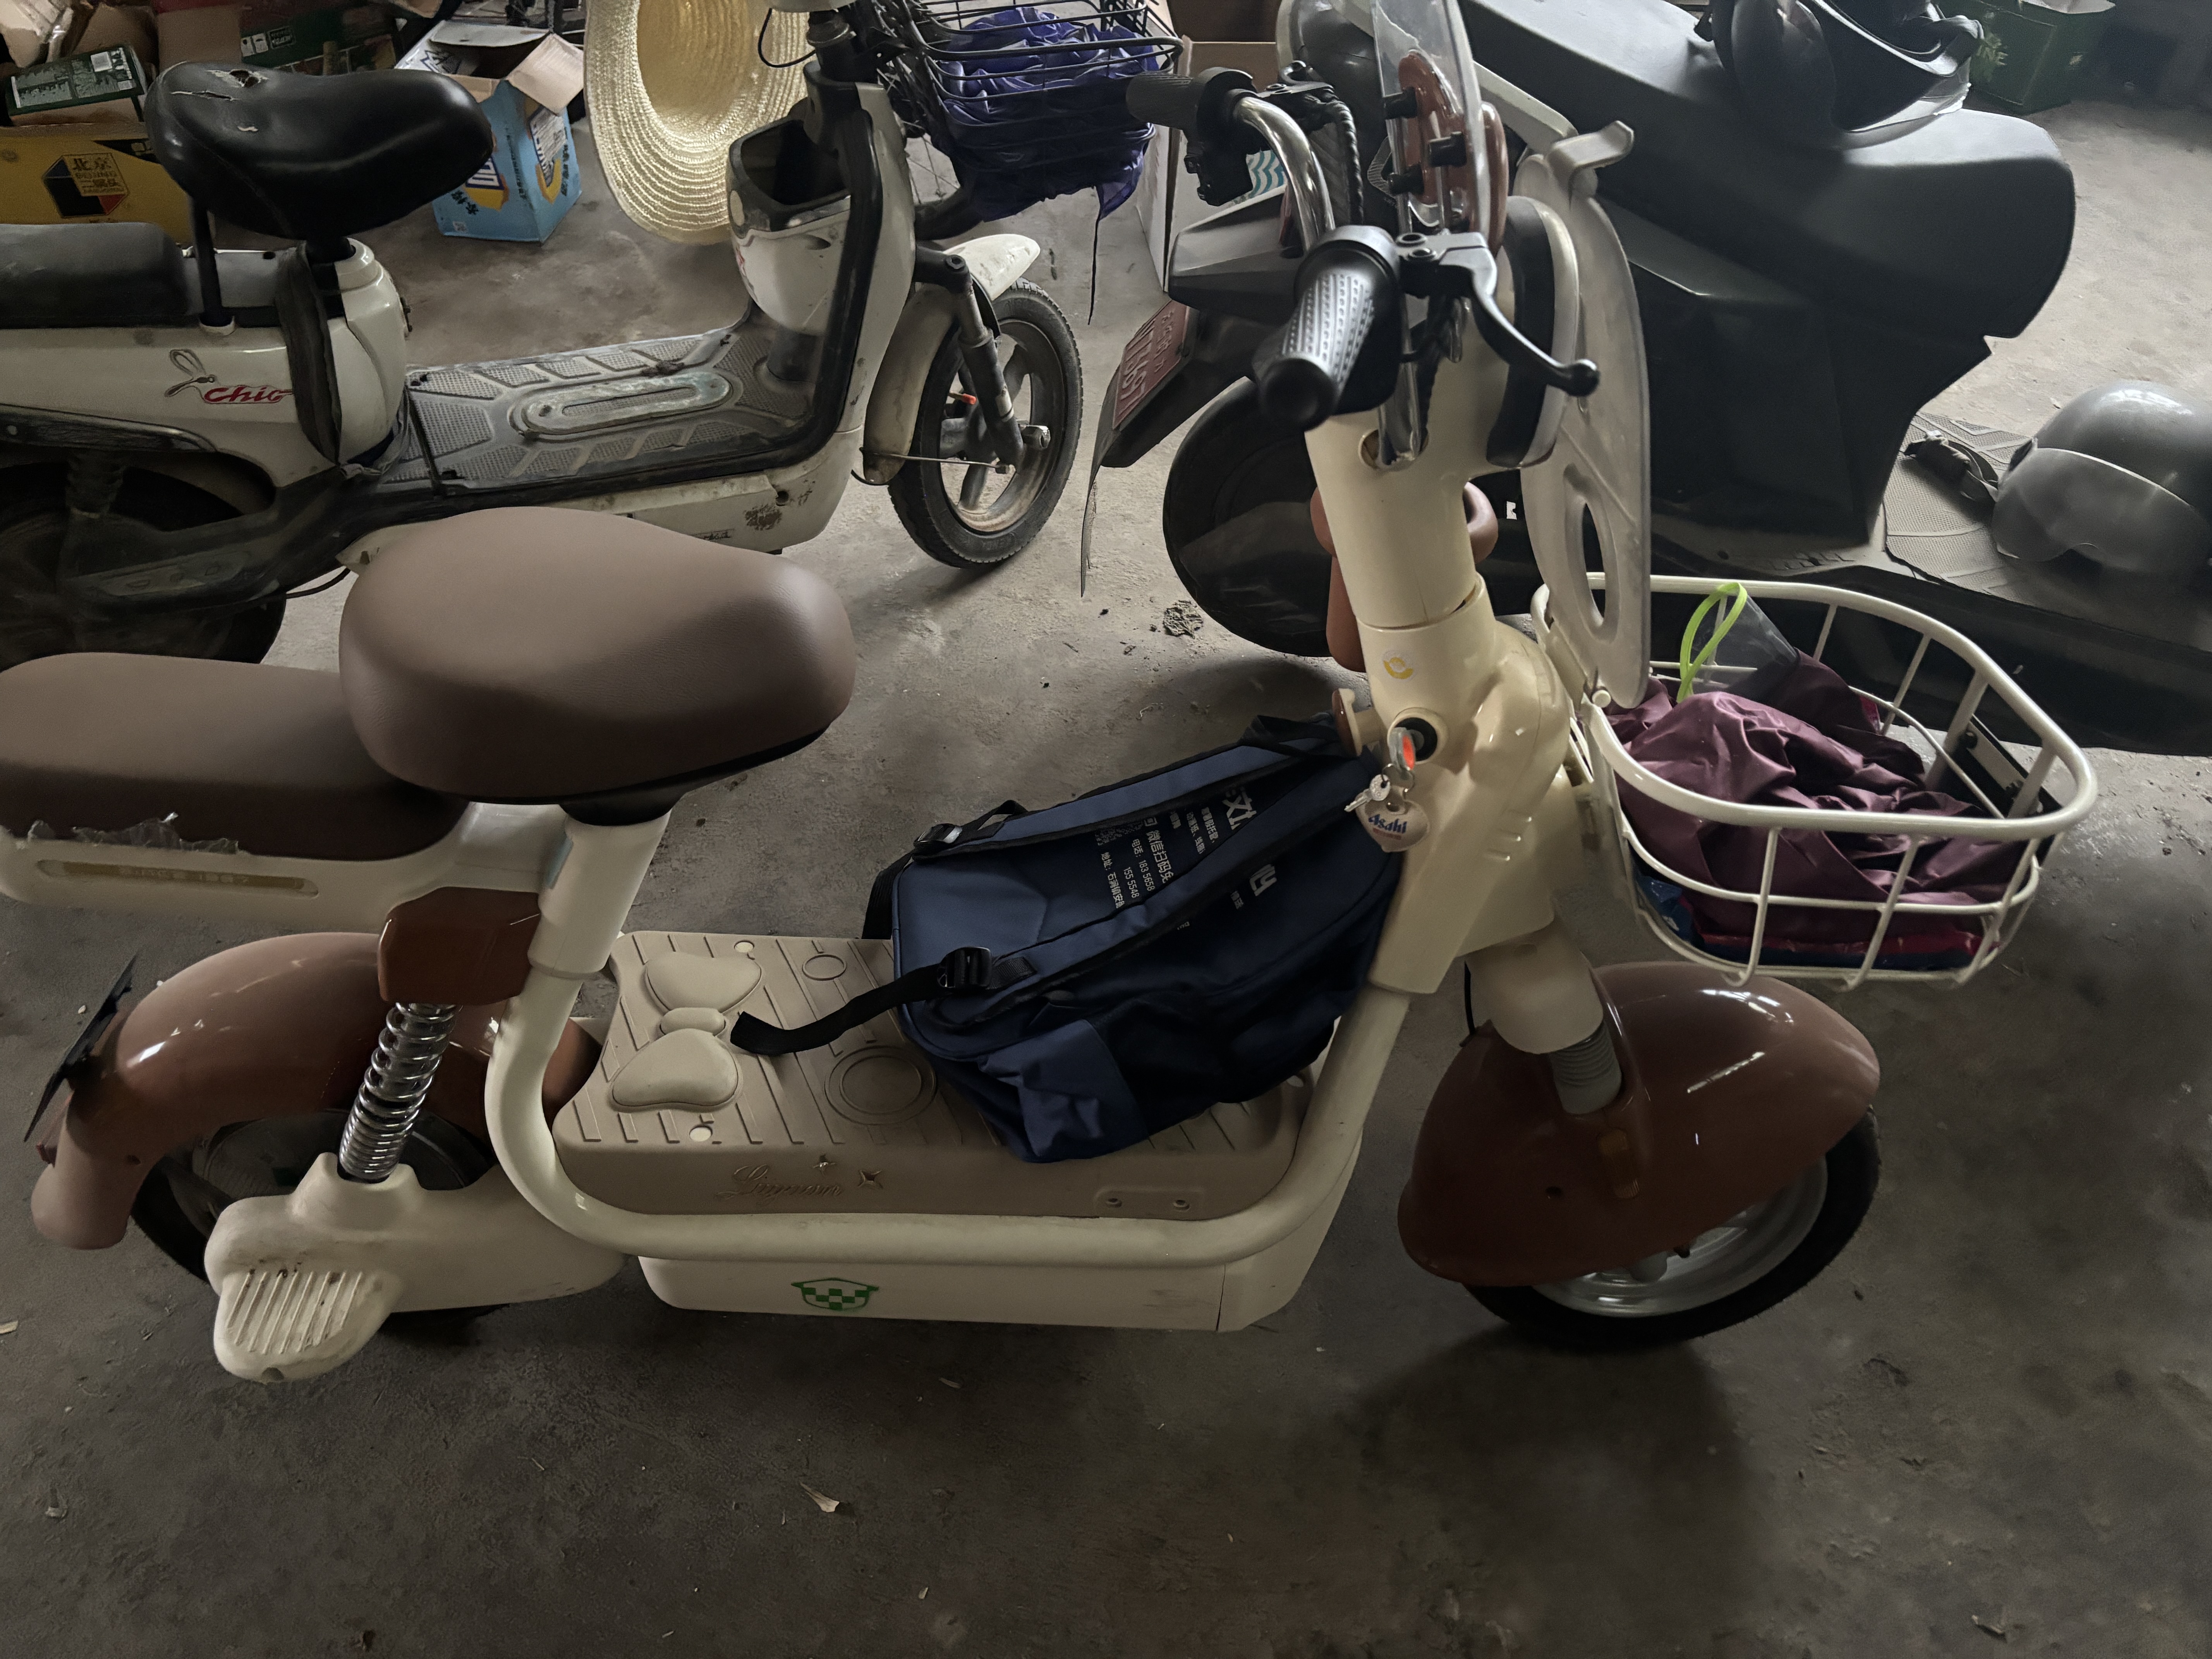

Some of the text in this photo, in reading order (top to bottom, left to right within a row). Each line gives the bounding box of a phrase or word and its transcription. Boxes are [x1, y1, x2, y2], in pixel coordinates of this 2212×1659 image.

[1369, 814, 1407, 833] Asahi
[1139, 860, 1149, 872] 183
[1146, 830, 1174, 884] 微信扫码免
[1123, 867, 1139, 898] 155 5548
[1142, 872, 1155, 891] 5658
